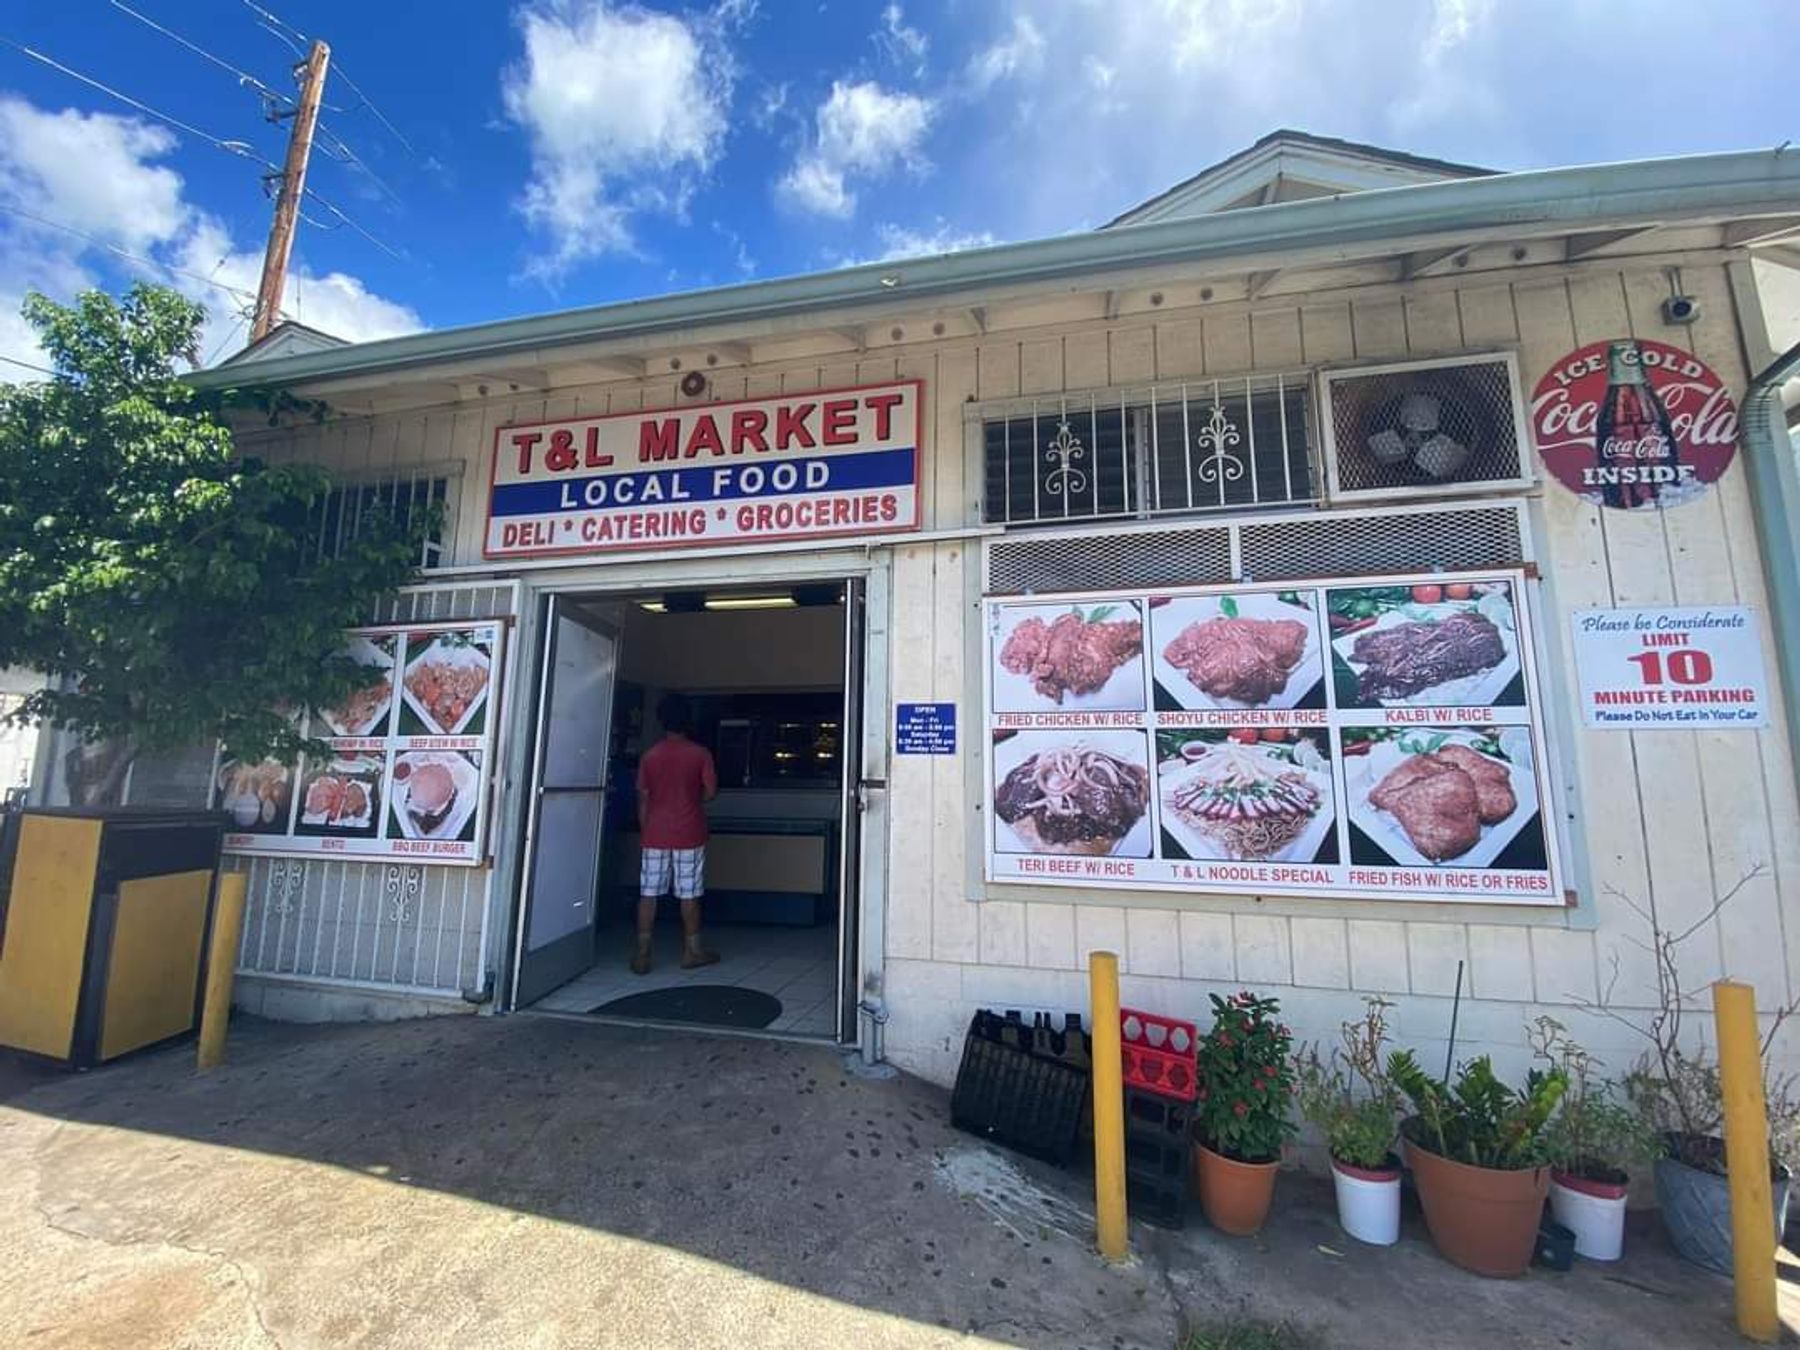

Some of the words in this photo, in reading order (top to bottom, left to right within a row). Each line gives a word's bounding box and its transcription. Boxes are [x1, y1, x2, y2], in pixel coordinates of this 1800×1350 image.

[1554, 354, 1607, 386] ICE
[1621, 349, 1704, 378] COLD
[1531, 388, 1598, 449] Coc
[513, 427, 614, 474] T&L
[638, 395, 904, 462] MARKET
[1583, 465, 1696, 485] INSIDE
[560, 471, 690, 509] LOCAL
[712, 461, 831, 497] FOOD
[502, 521, 555, 549] DELI
[581, 509, 706, 542] CATERING
[735, 494, 898, 532] GROCERIES
[1582, 614, 1630, 632] Please
[1633, 613, 1651, 631] be
[1656, 611, 1745, 631] Considerate
[1642, 632, 1690, 647] LIMIT
[1627, 650, 1713, 685] 10
[1593, 691, 1668, 705] MINUTE
[1672, 688, 1755, 703] PARKING
[998, 714, 1033, 726] FRIED
[1036, 713, 1091, 726] CHICKEN
[1093, 713, 1110, 726] W/
[1113, 713, 1143, 725] RICE
[1157, 713, 1204, 725] SHOYU
[1207, 712, 1269, 725] CHICKEN
[1294, 711, 1327, 724] RICE
[1386, 709, 1430, 722] KALBI
[1457, 708, 1493, 721] RICE
[1595, 709, 1633, 722] Please
[1635, 710, 1650, 722] Do
[1652, 710, 1674, 722] Not
[1677, 710, 1697, 721] Eat
[1710, 709, 1737, 720] Your
[1738, 708, 1758, 720] Car
[1017, 858, 1045, 872] TERI
[1049, 859, 1081, 873] BEEF
[1104, 862, 1135, 876] RICE
[1171, 865, 1178, 878] T
[1209, 866, 1267, 881] NOODLE
[1271, 868, 1334, 883] SPECIAL
[1349, 871, 1388, 885] FRIED
[1391, 872, 1422, 886] FISH
[1446, 874, 1479, 888] RICE
[1481, 875, 1502, 888] OR
[1506, 876, 1548, 890] FRIES
